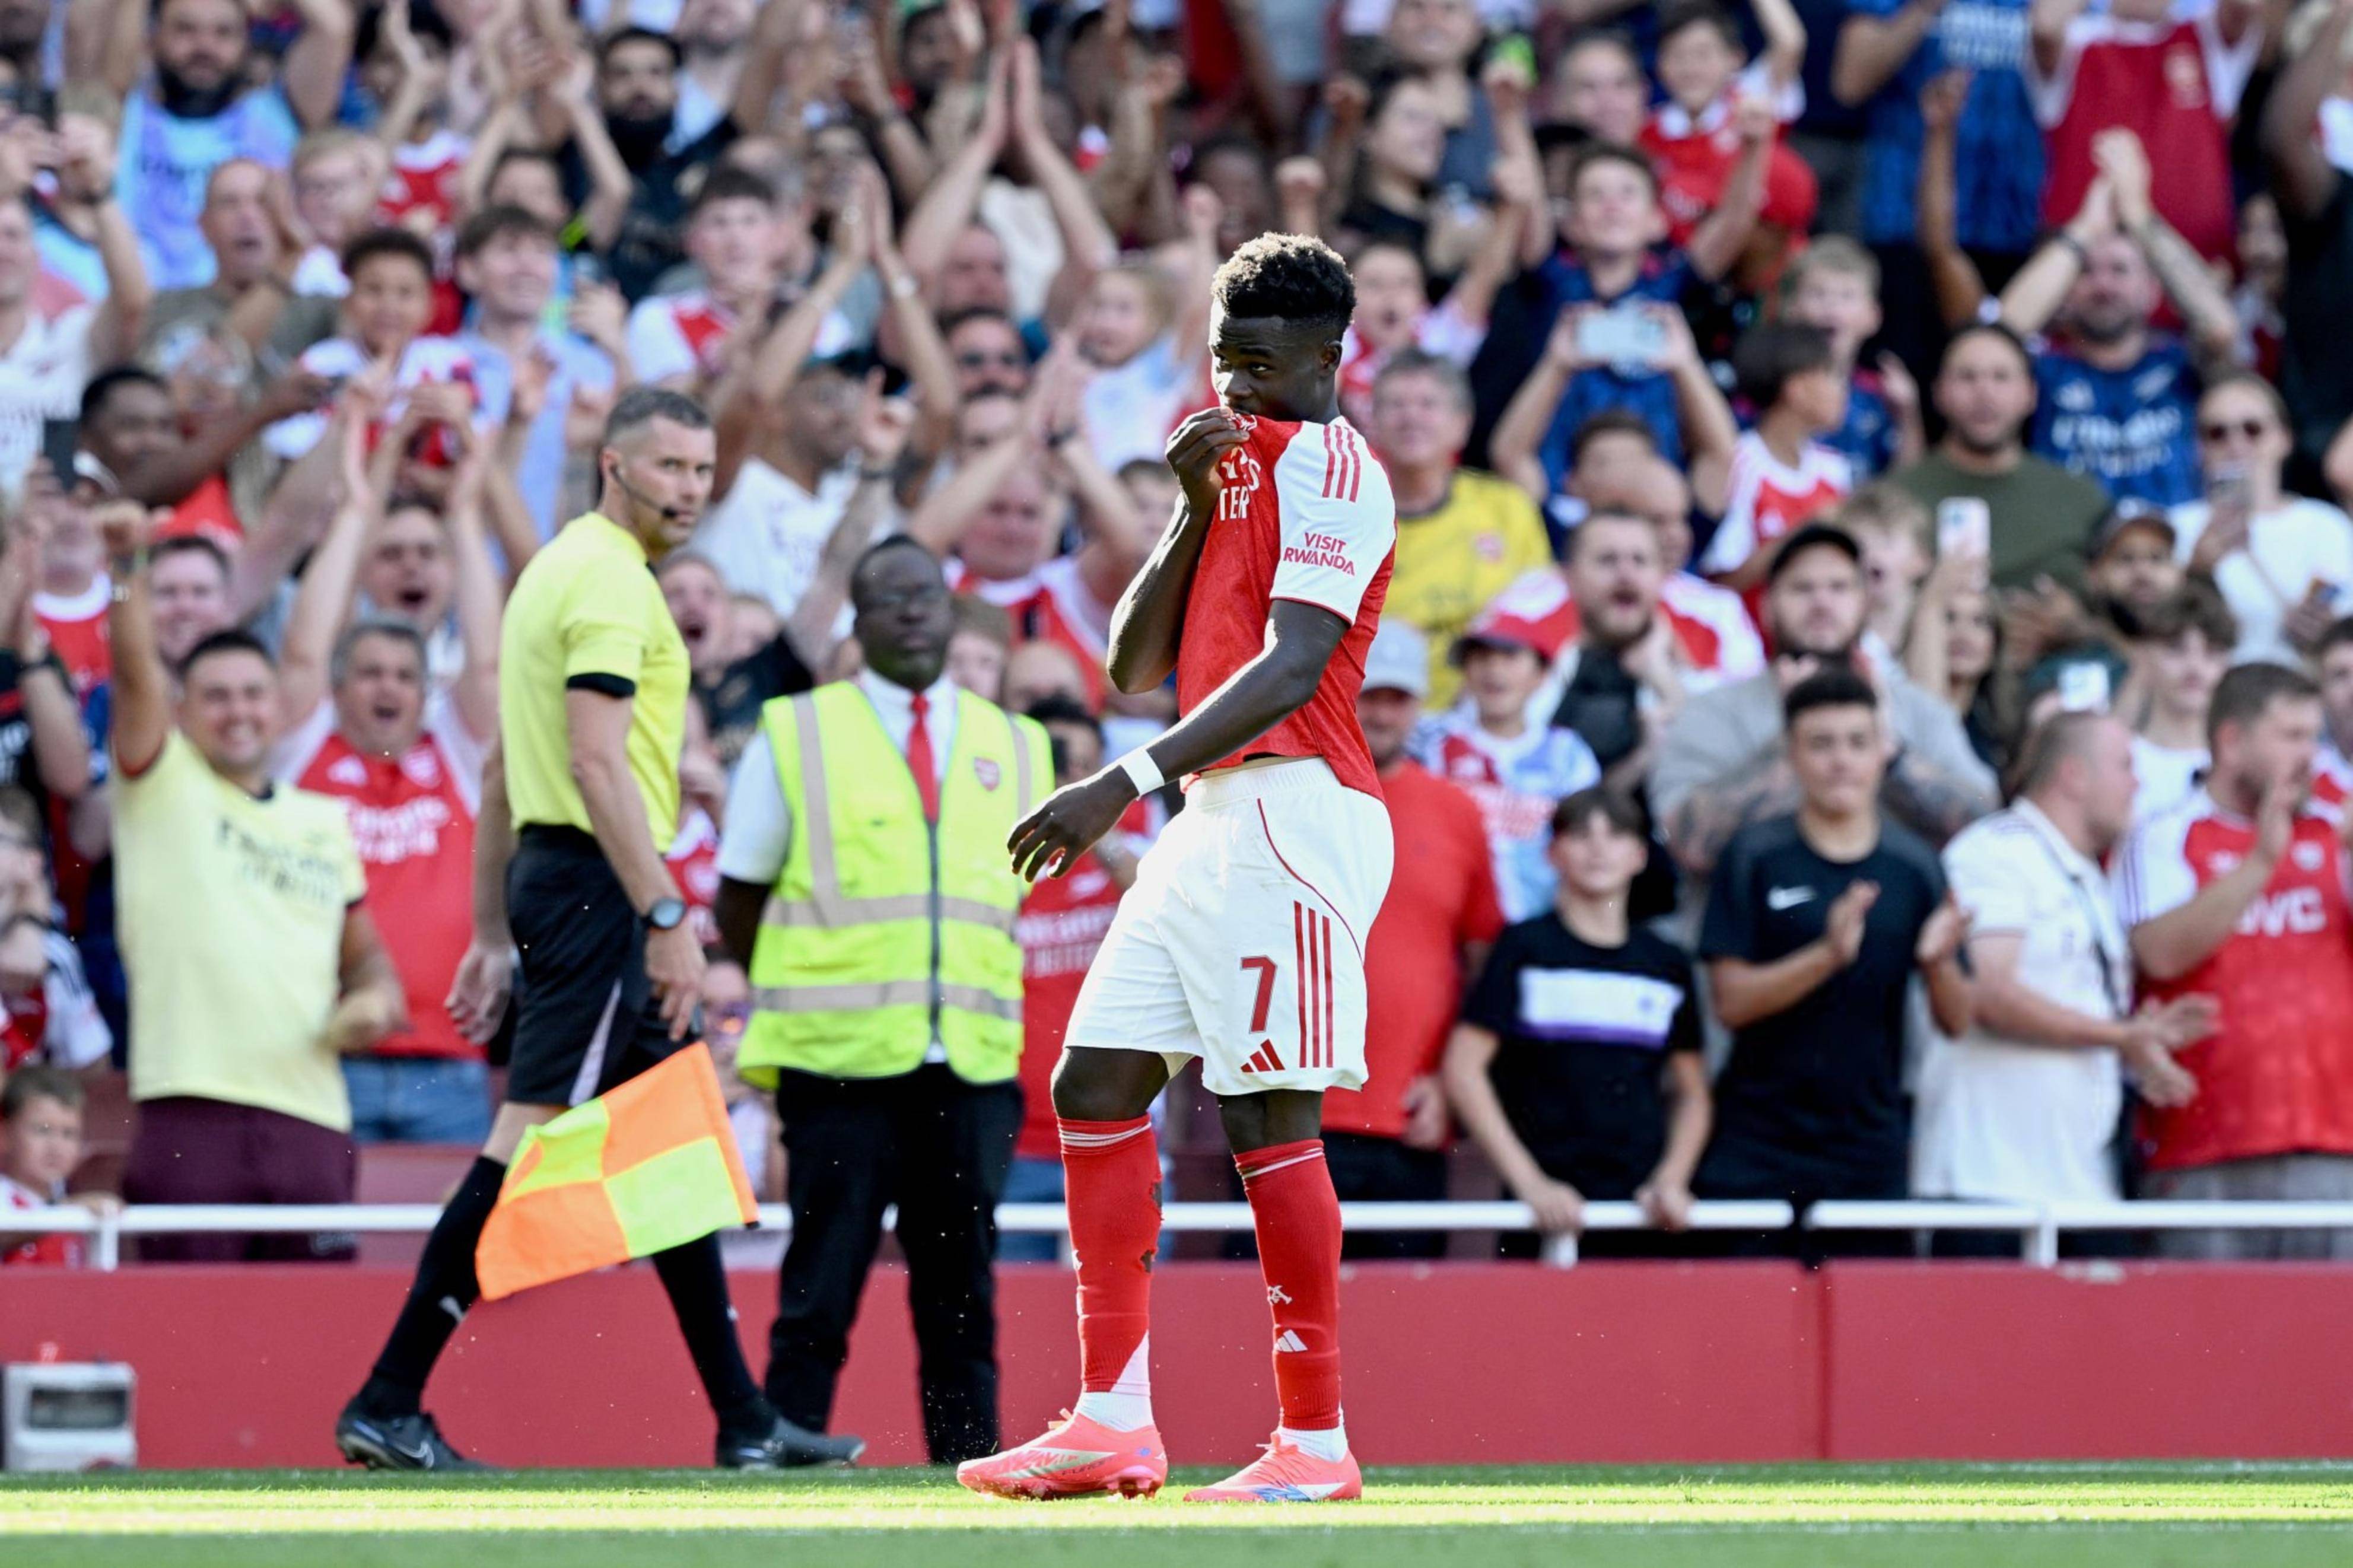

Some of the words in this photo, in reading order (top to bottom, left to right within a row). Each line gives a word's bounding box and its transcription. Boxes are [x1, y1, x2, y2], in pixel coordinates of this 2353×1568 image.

[1220, 485, 1250, 521] TER
[1305, 532, 1347, 553] VISIT
[1283, 546, 1355, 576] RWANDA
[1241, 955, 1277, 1034] 7
